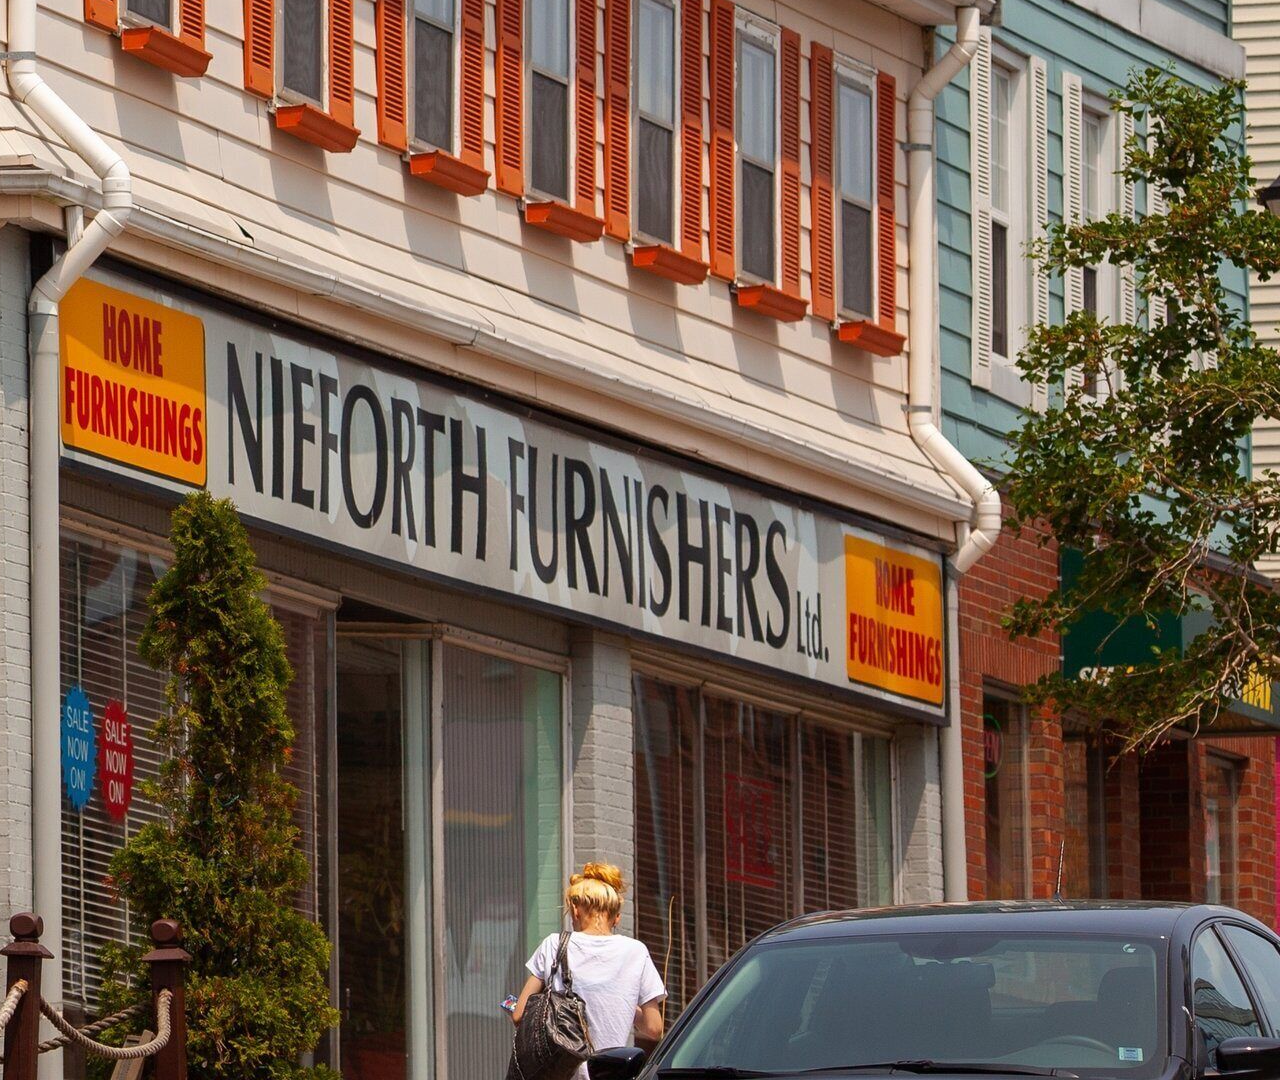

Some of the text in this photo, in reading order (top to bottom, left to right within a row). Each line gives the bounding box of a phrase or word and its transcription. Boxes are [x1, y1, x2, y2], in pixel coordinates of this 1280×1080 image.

[102, 302, 164, 378] HOME
[64, 366, 203, 466] FURNISHINGS
[227, 341, 830, 664] NIEFORTH FURNISHERS Ltd.
[875, 557, 915, 616] HOME
[849, 612, 941, 687] FURNISHINGS
[66, 706, 89, 733] SALE
[105, 718, 127, 747] SALE
[67, 735, 89, 762] NOW
[105, 749, 127, 775] NOW
[70, 766, 86, 791] ON!
[108, 780, 125, 805] ON!
